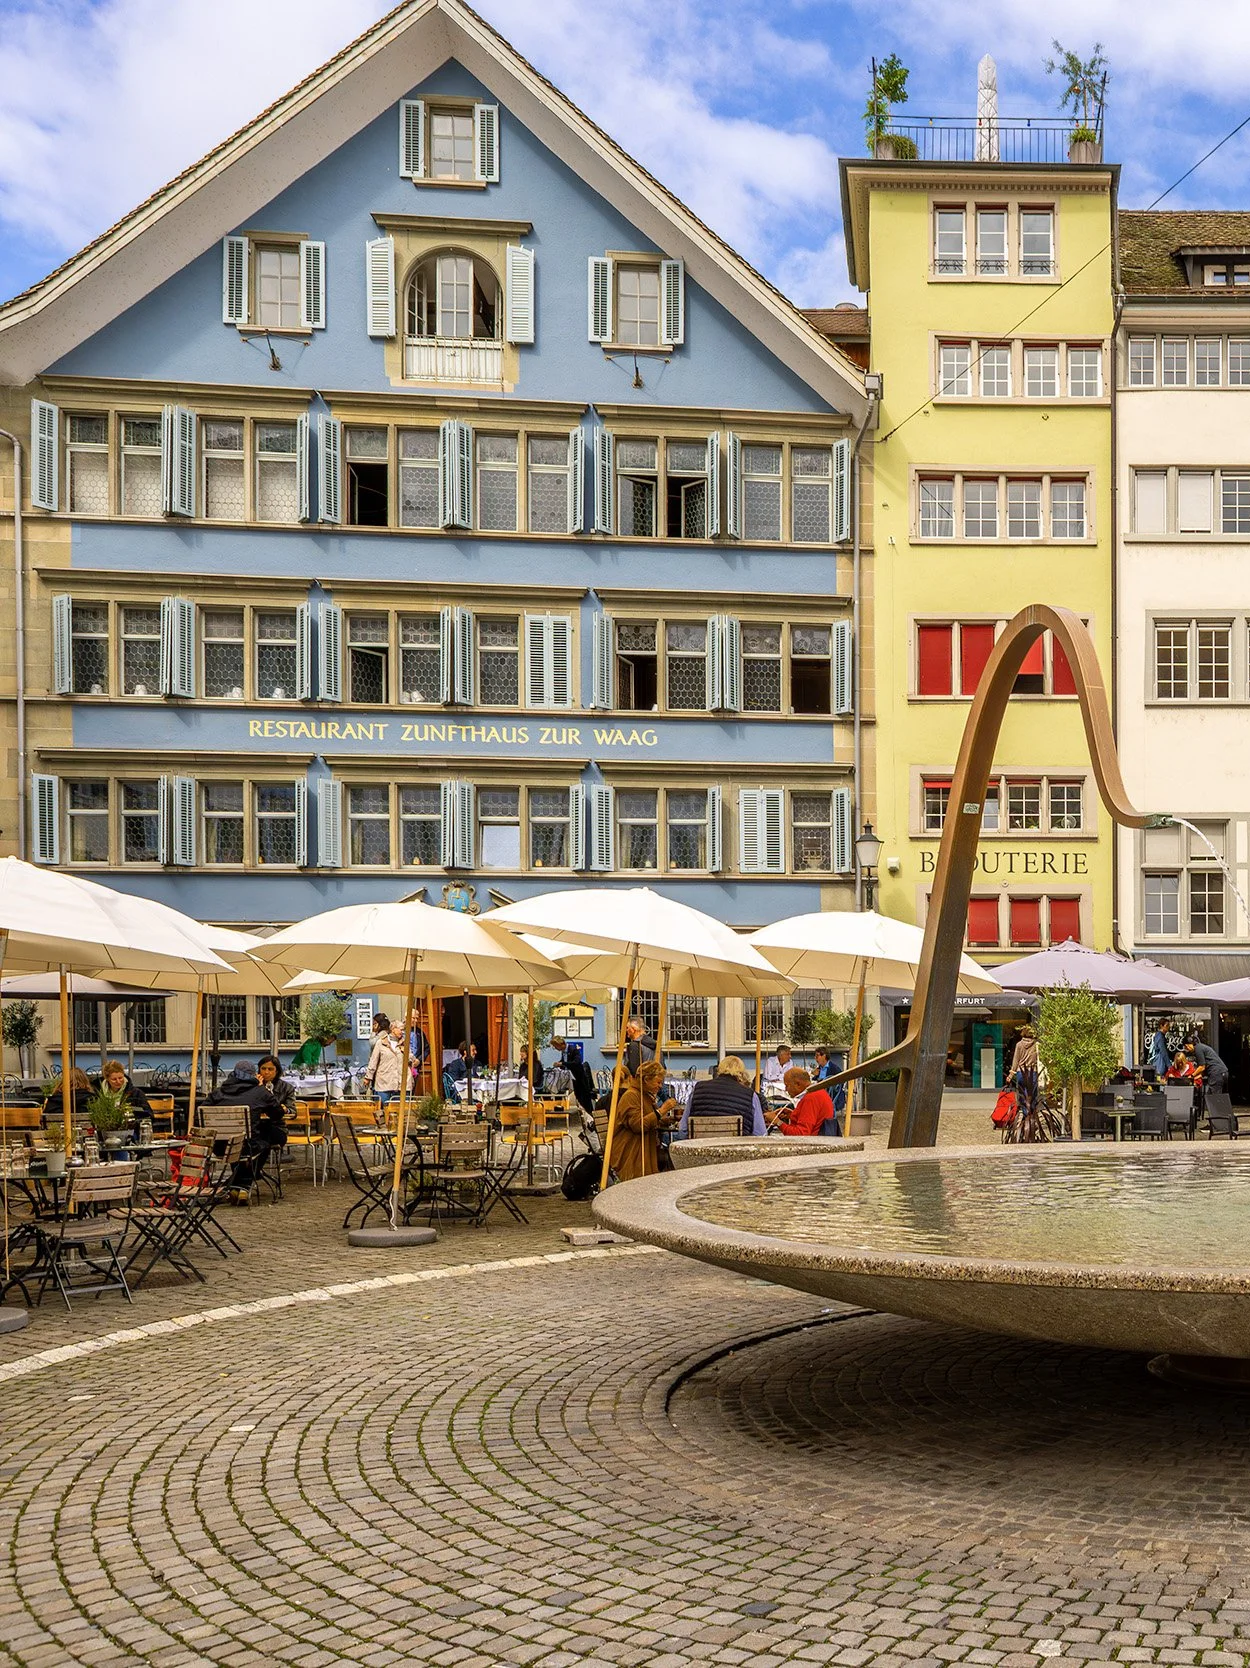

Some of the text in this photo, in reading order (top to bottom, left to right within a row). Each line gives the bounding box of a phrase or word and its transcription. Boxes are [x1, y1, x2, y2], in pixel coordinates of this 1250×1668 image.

[249, 719, 659, 747] RESTAURANT ZUNFTHAUS ZUR WAAG
[919, 851, 1089, 875] BUTERIE
